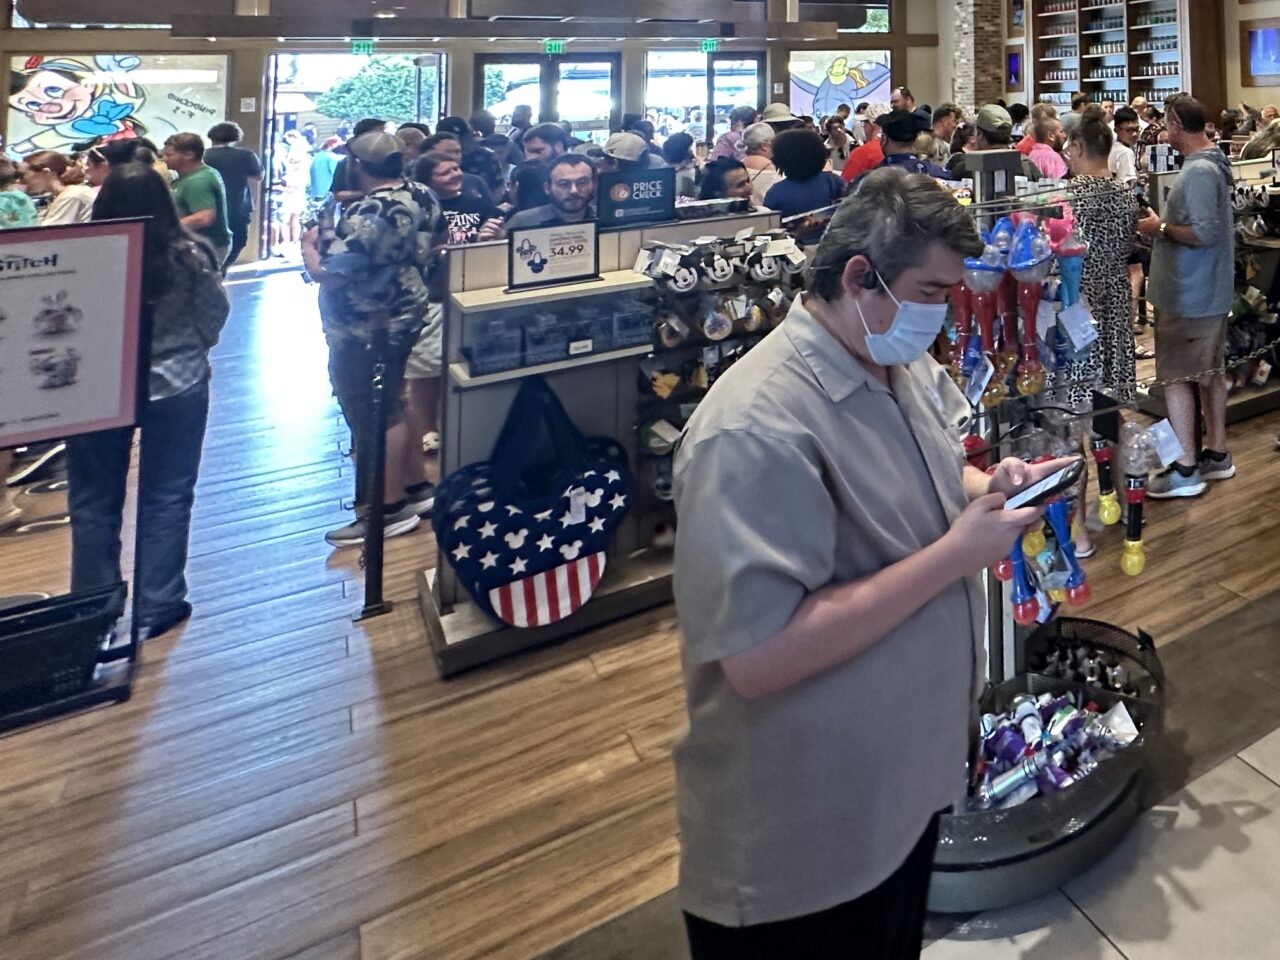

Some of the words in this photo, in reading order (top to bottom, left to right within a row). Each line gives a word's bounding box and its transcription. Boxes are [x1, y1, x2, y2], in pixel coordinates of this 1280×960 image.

[352, 41, 373, 54] EXIT
[546, 41, 564, 54] EXIT
[702, 40, 717, 52] EXIT
[633, 180, 663, 191] PRICE
[632, 189, 662, 199] CHECK
